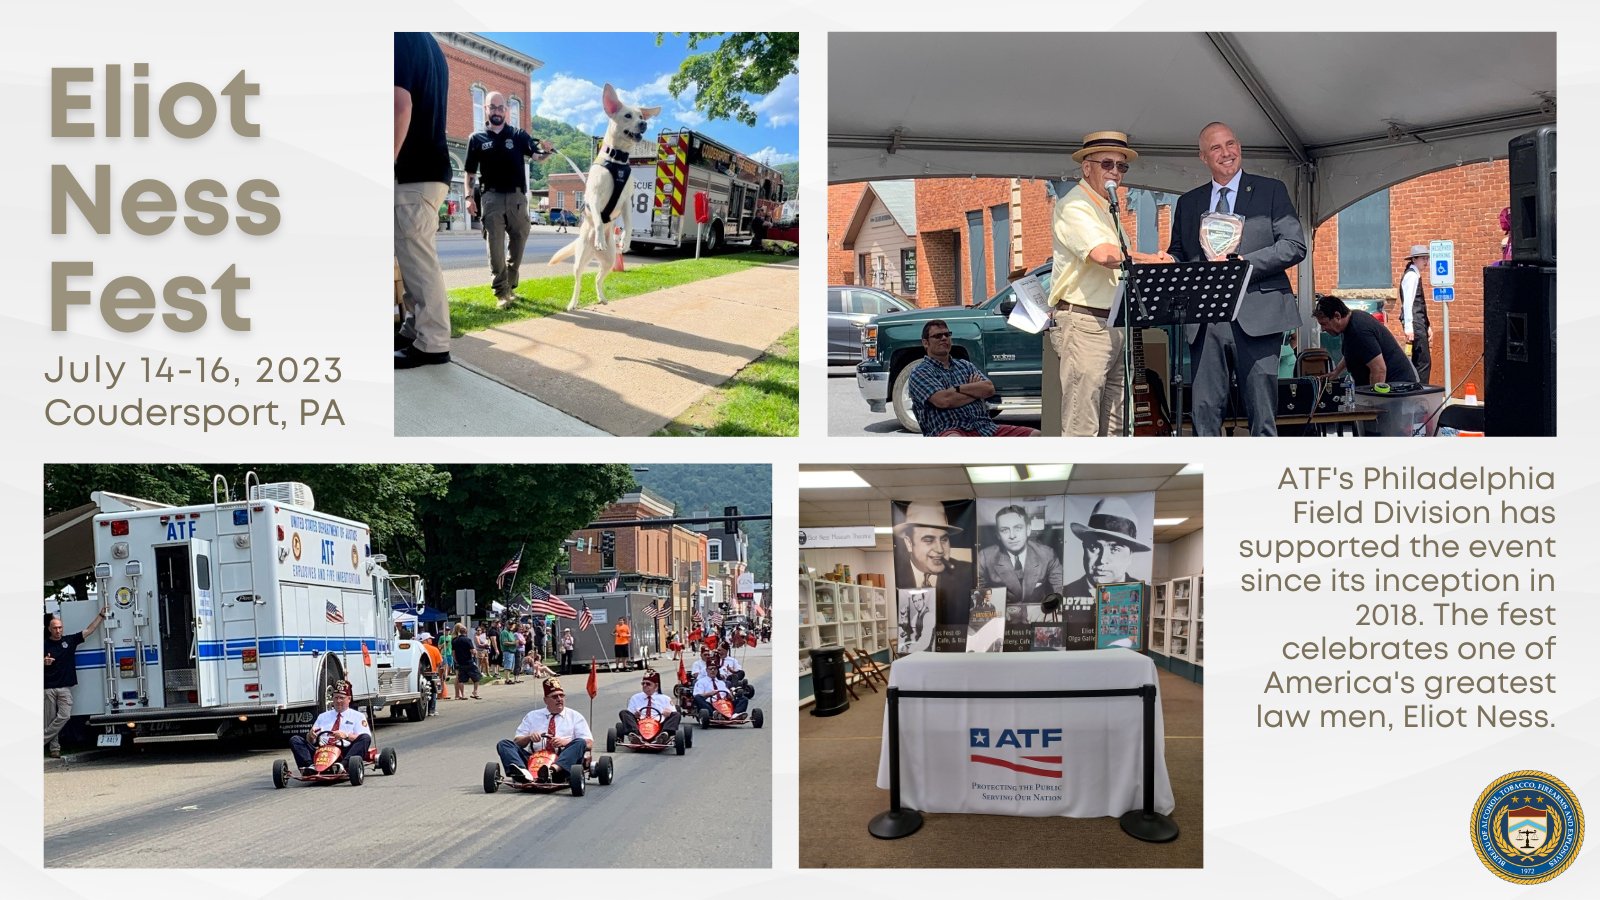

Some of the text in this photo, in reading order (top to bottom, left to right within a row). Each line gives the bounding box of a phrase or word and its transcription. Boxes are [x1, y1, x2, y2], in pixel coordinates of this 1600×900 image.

[167, 520, 197, 541] ATF
[290, 515, 304, 529] UNITED
[305, 518, 317, 533] STATES
[318, 521, 339, 537] DEPARTMENT
[321, 539, 335, 566] ATF
[279, 712, 302, 724] LDV
[995, 728, 1063, 748] ATF
